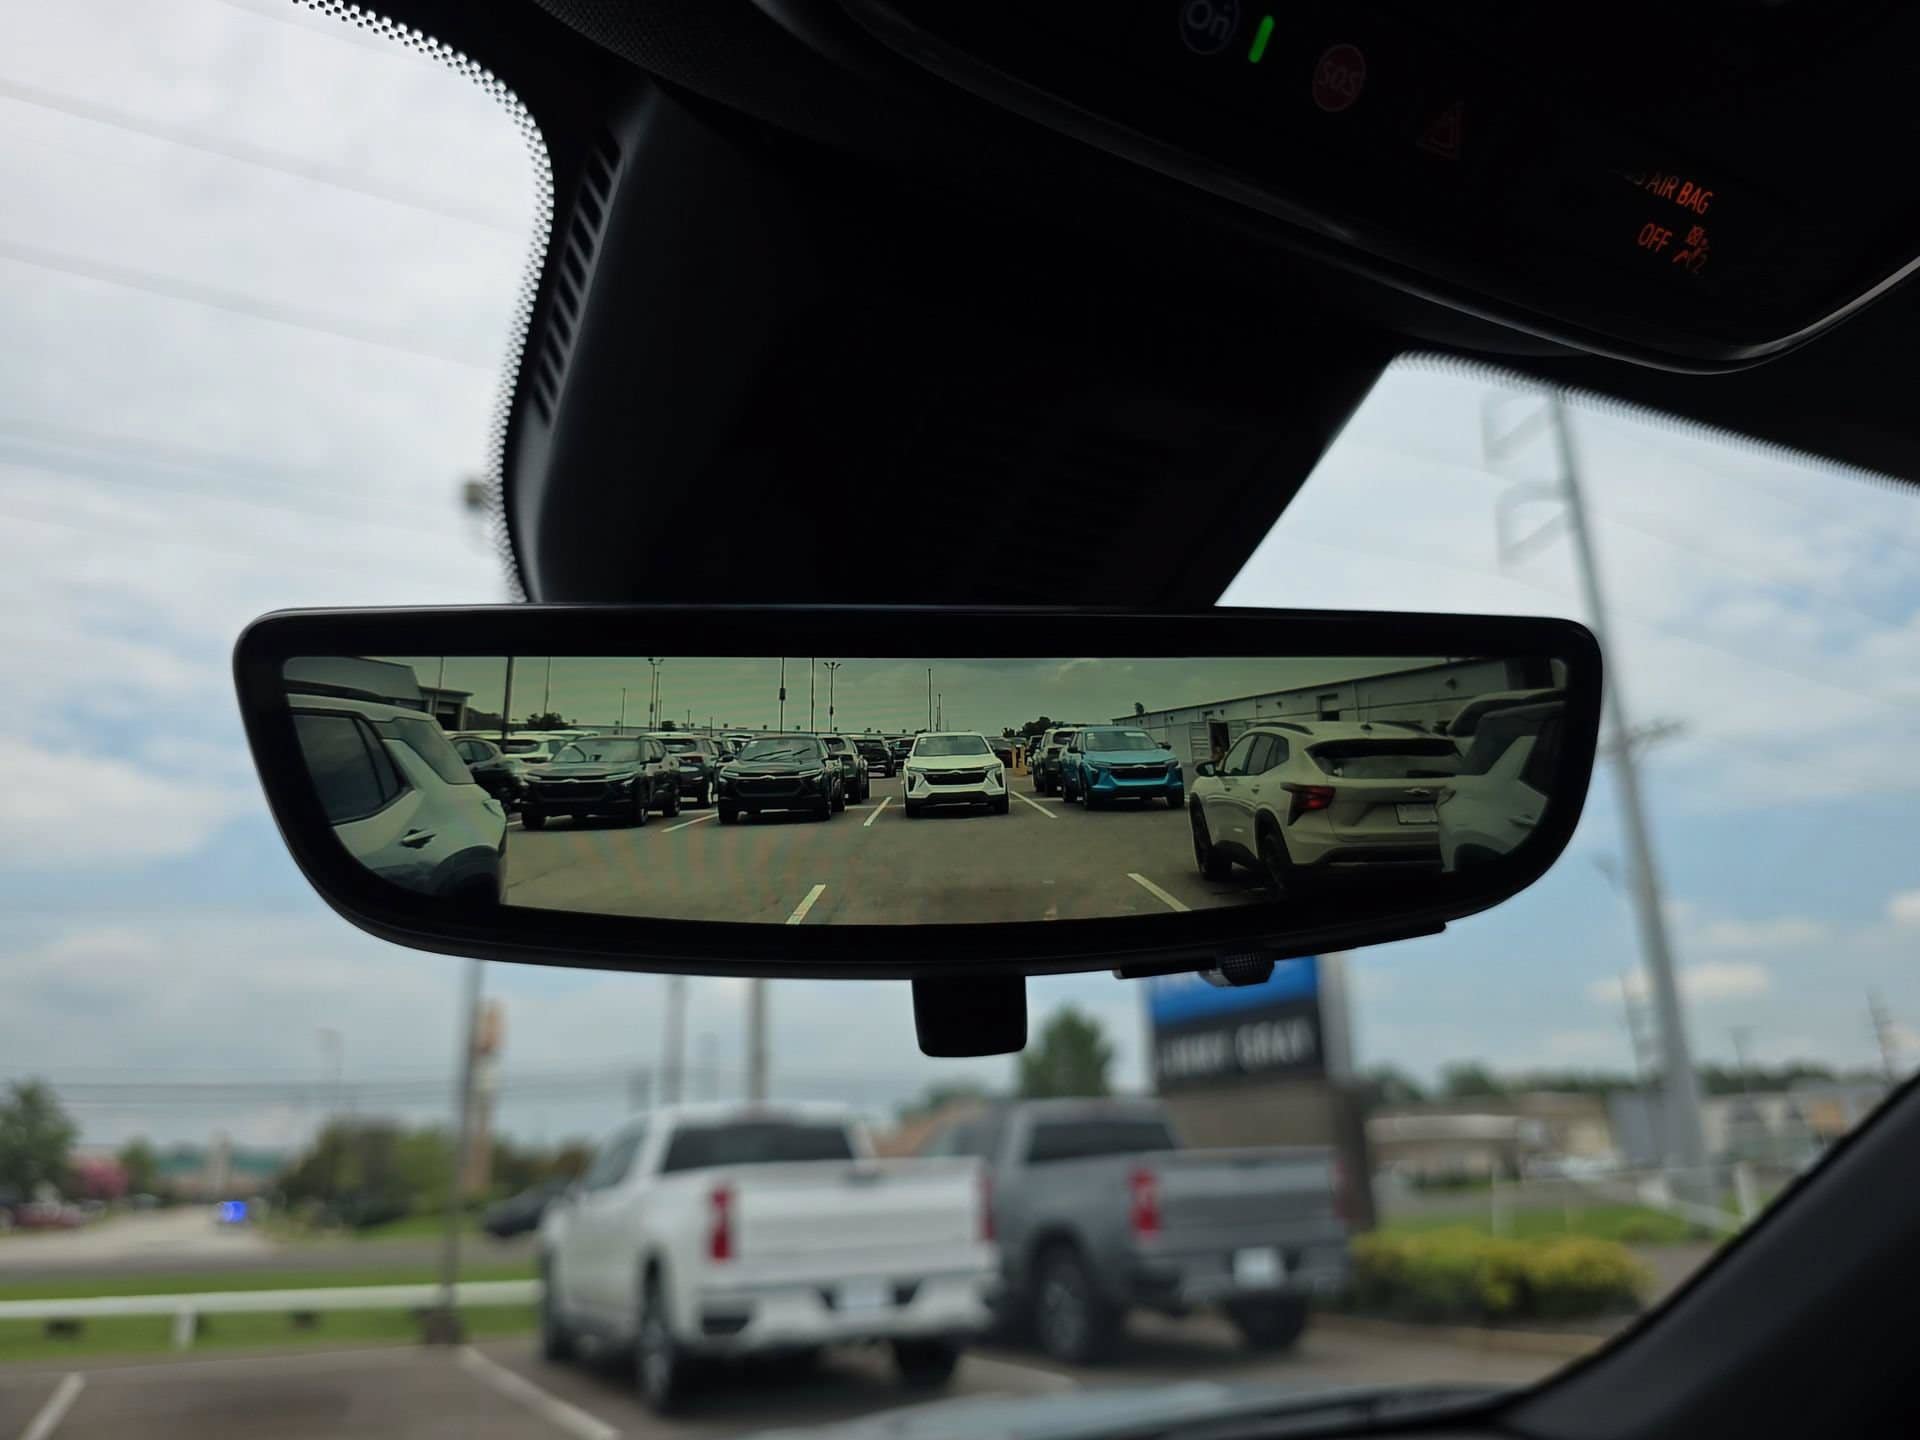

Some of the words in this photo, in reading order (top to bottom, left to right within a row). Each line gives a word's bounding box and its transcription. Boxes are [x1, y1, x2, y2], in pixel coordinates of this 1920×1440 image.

[1317, 59, 1362, 97] SOS
[1645, 172, 1680, 199] AIR
[1675, 180, 1713, 215] BAG
[1638, 222, 1673, 252] OFF
